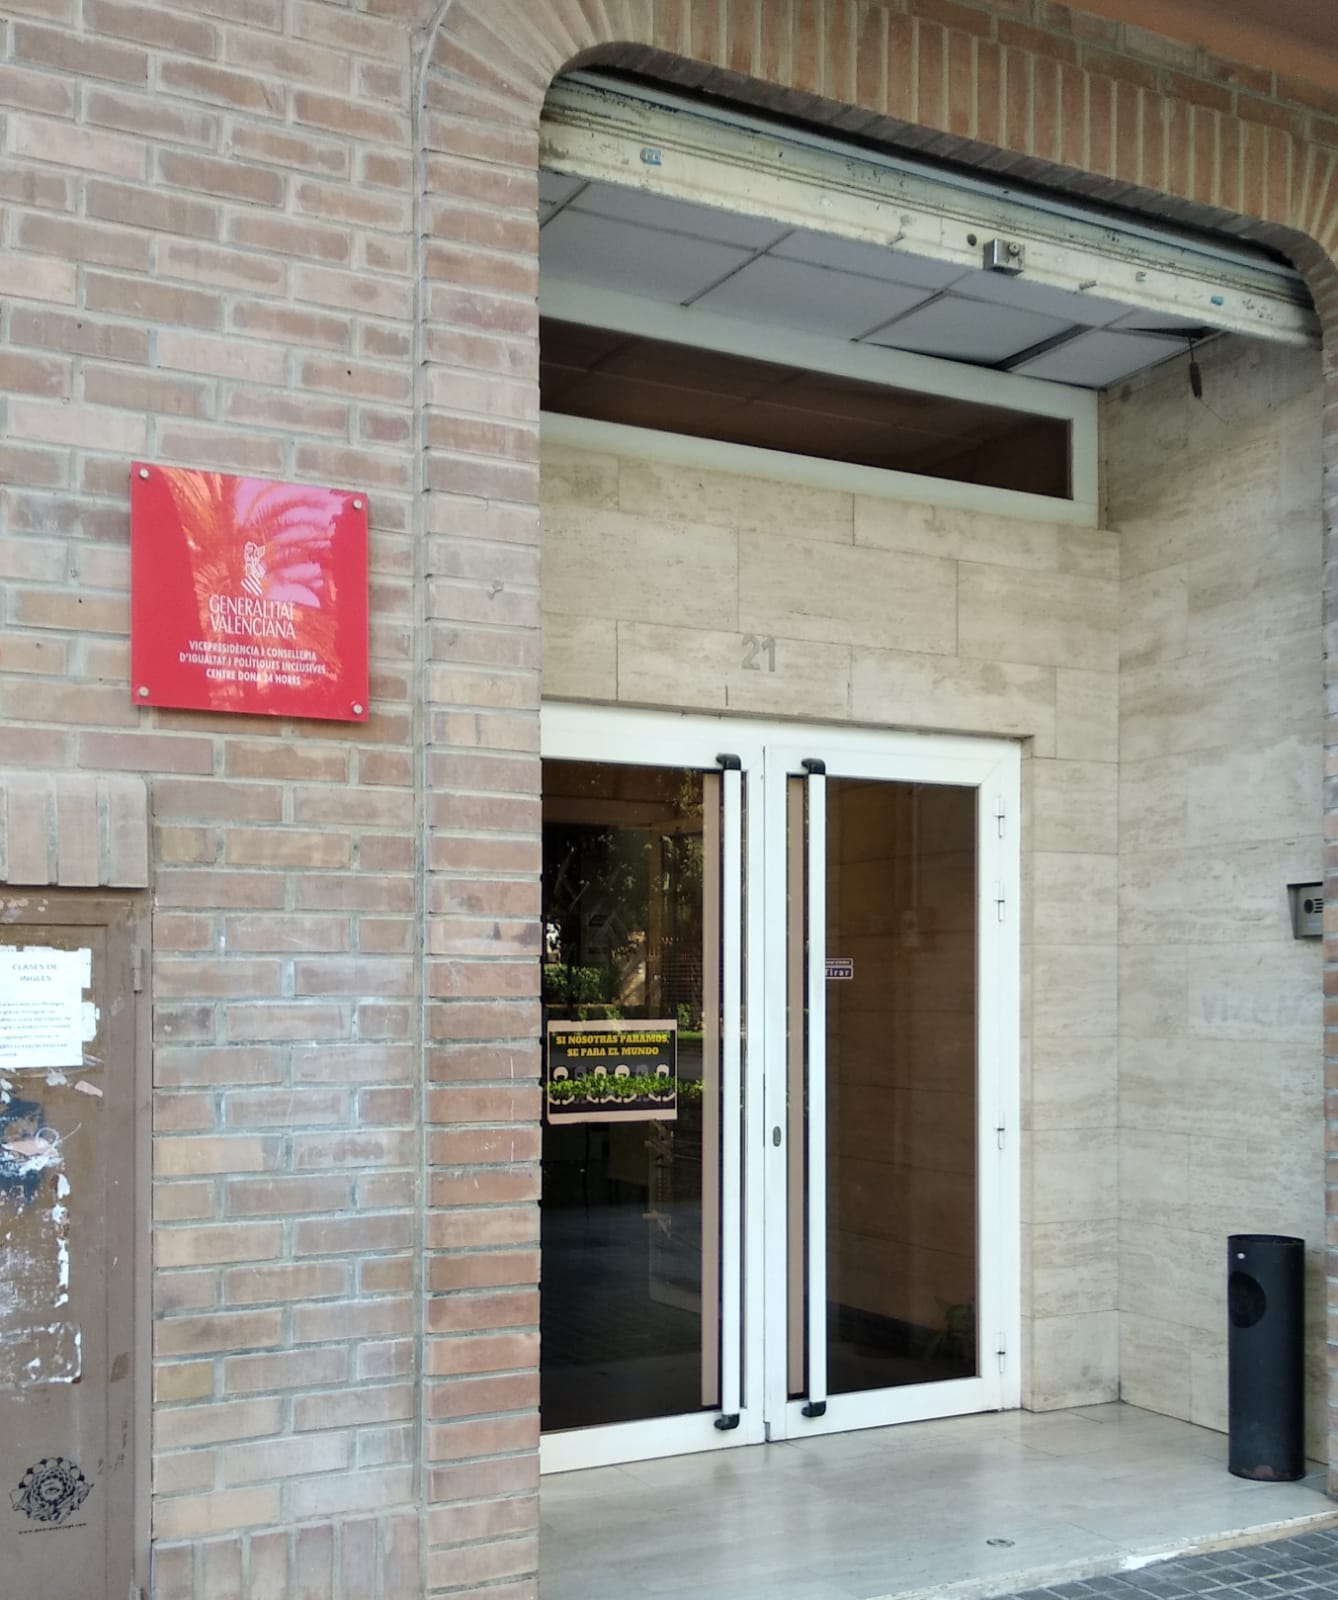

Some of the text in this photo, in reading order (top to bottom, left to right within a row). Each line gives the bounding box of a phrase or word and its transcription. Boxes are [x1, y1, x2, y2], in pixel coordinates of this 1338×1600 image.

[209, 595, 295, 620] GENERALITAT
[210, 613, 296, 639] VALENCIANA
[267, 648, 317, 661] CONSELLERIA
[742, 633, 775, 672] 21
[282, 663, 326, 674] INCLUSIVES
[206, 668, 301, 685] CENTRE DONA 24 HORES
[556, 1036, 567, 1045] SI
[568, 1035, 618, 1045] NOSOTRAS
[567, 1047, 659, 1057] SE PARA EL MUNDO
